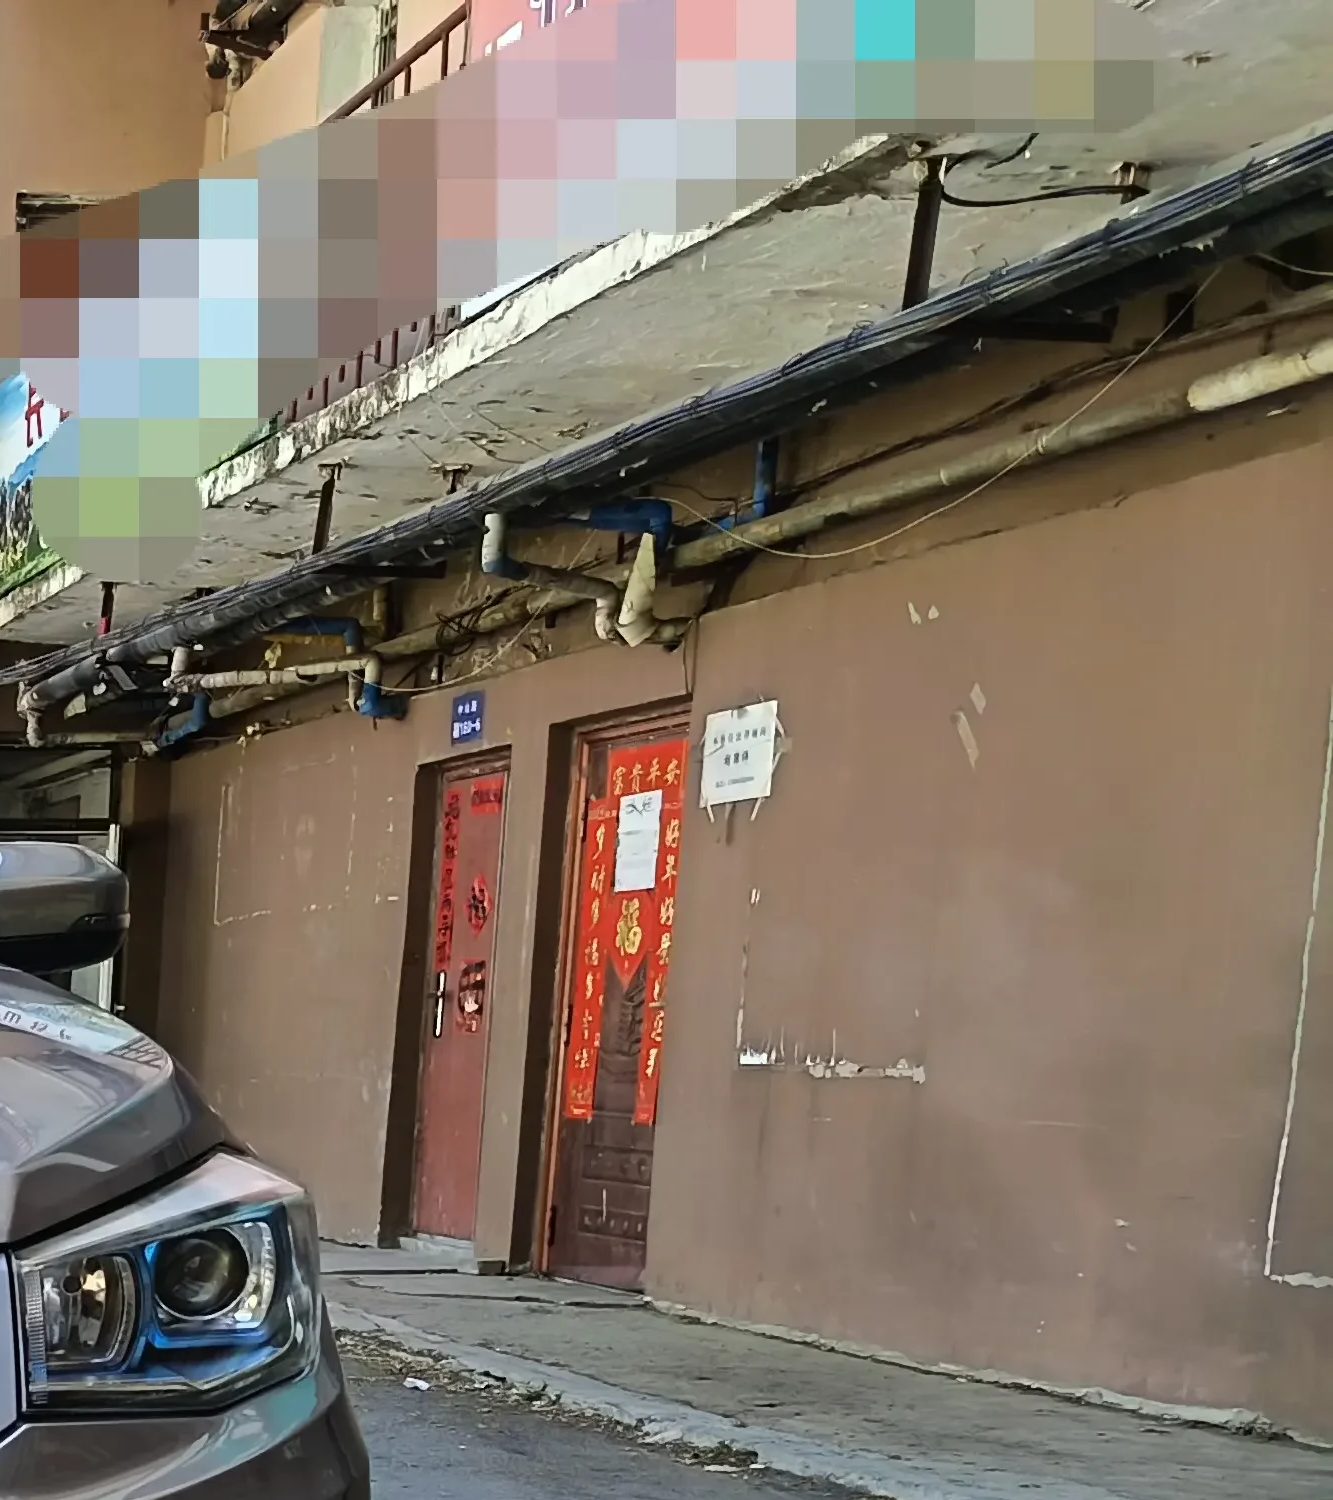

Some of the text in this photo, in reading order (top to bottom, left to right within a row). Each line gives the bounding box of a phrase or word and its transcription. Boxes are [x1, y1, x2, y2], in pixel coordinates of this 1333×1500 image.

[612, 756, 681, 796] 富贵平安
[615, 897, 643, 956] 福
